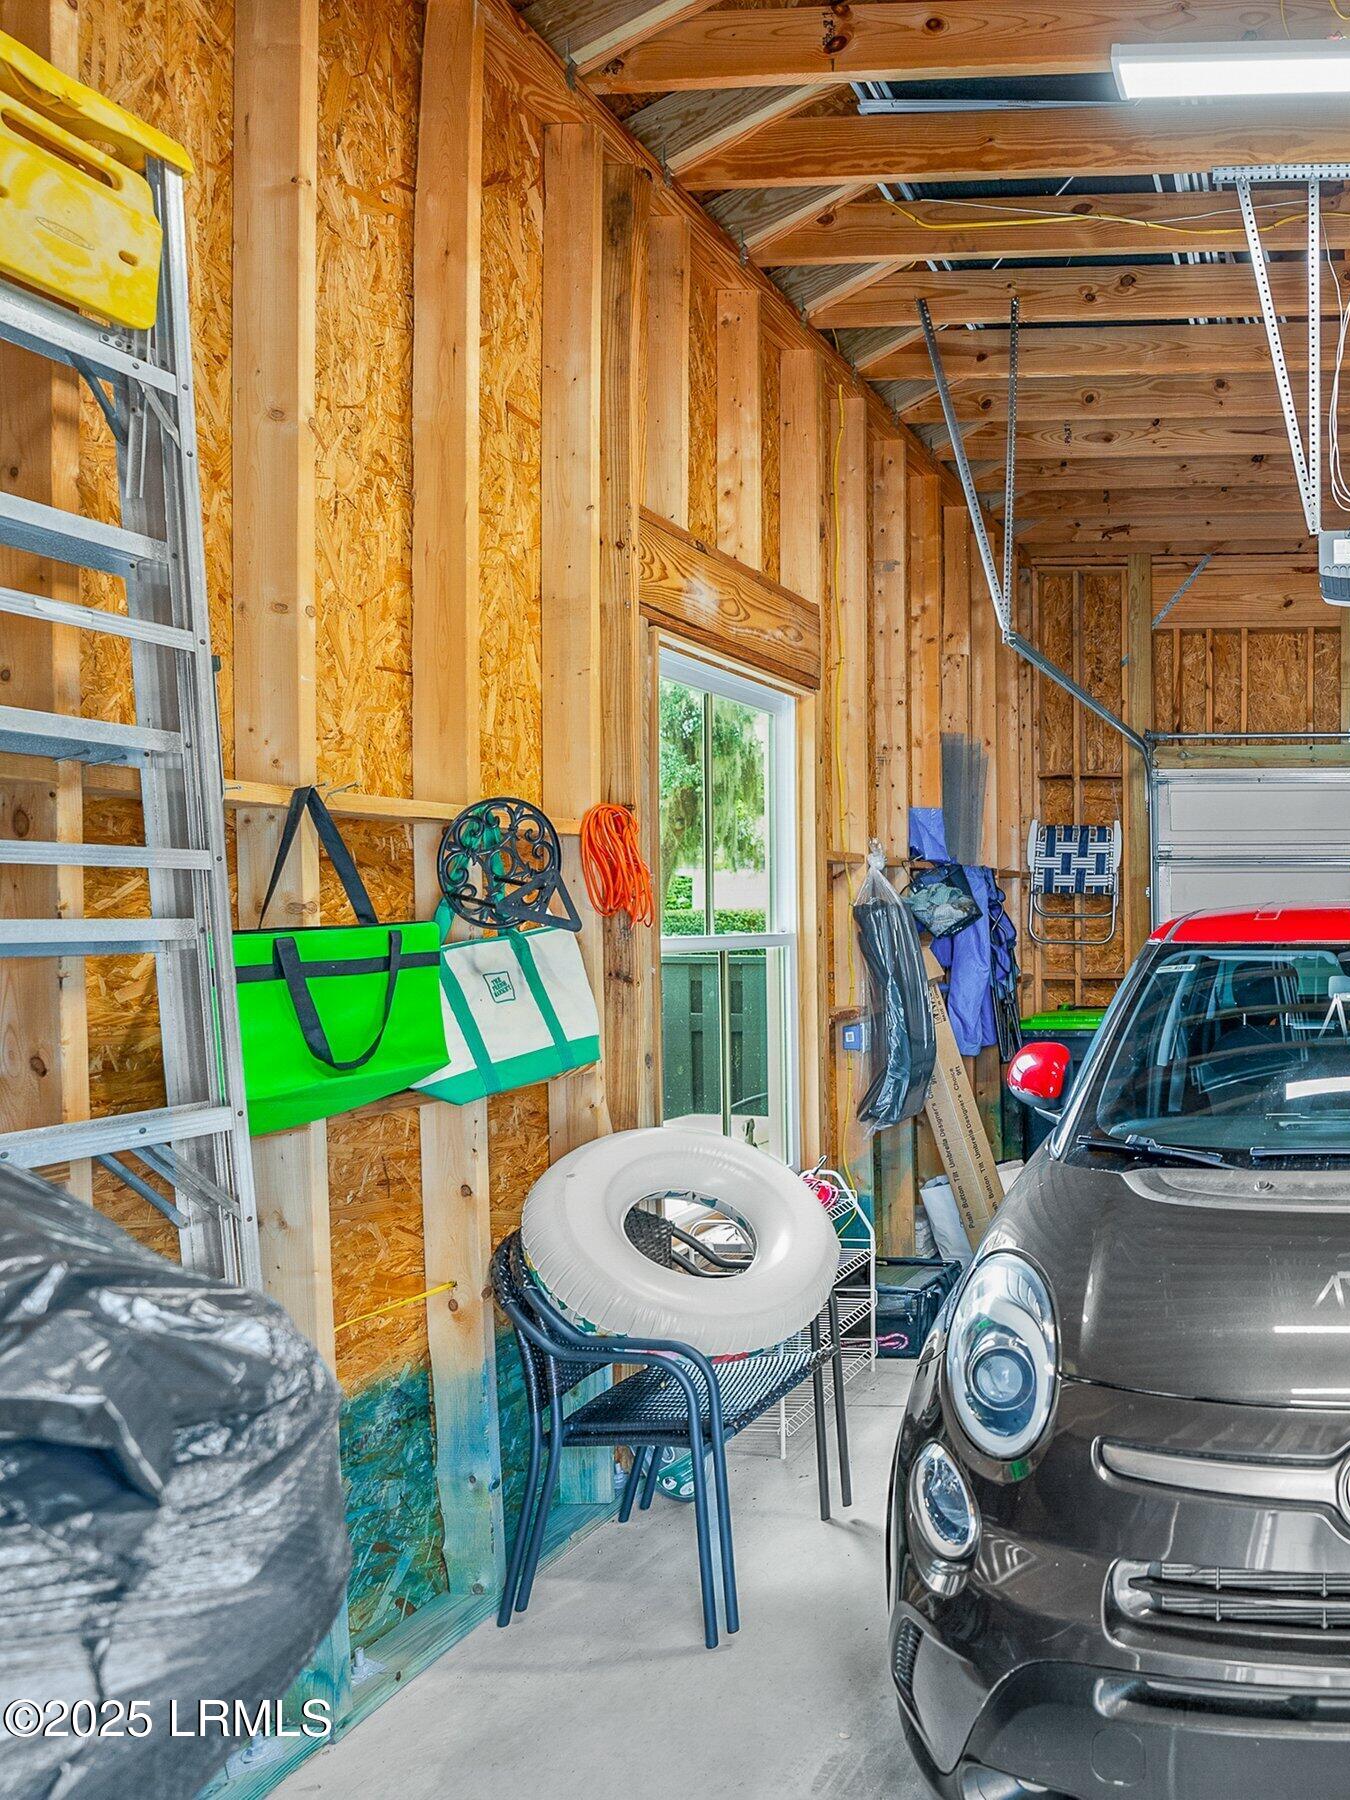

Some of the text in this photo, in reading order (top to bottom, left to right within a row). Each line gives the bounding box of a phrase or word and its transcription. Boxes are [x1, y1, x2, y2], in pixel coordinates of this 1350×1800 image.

[949, 1067, 960, 1091] Choice
[931, 1102, 946, 1138] Designer's
[957, 1094, 972, 1129] Designer's
[942, 1138, 956, 1168] Umbrella
[968, 1128, 982, 1159] Umbrella
[952, 1170, 960, 1183] Tilt
[978, 1161, 986, 1173] Tilt
[958, 1185, 969, 1209] Button
[984, 1175, 995, 1199] Button
[966, 1211, 975, 1229] Push
